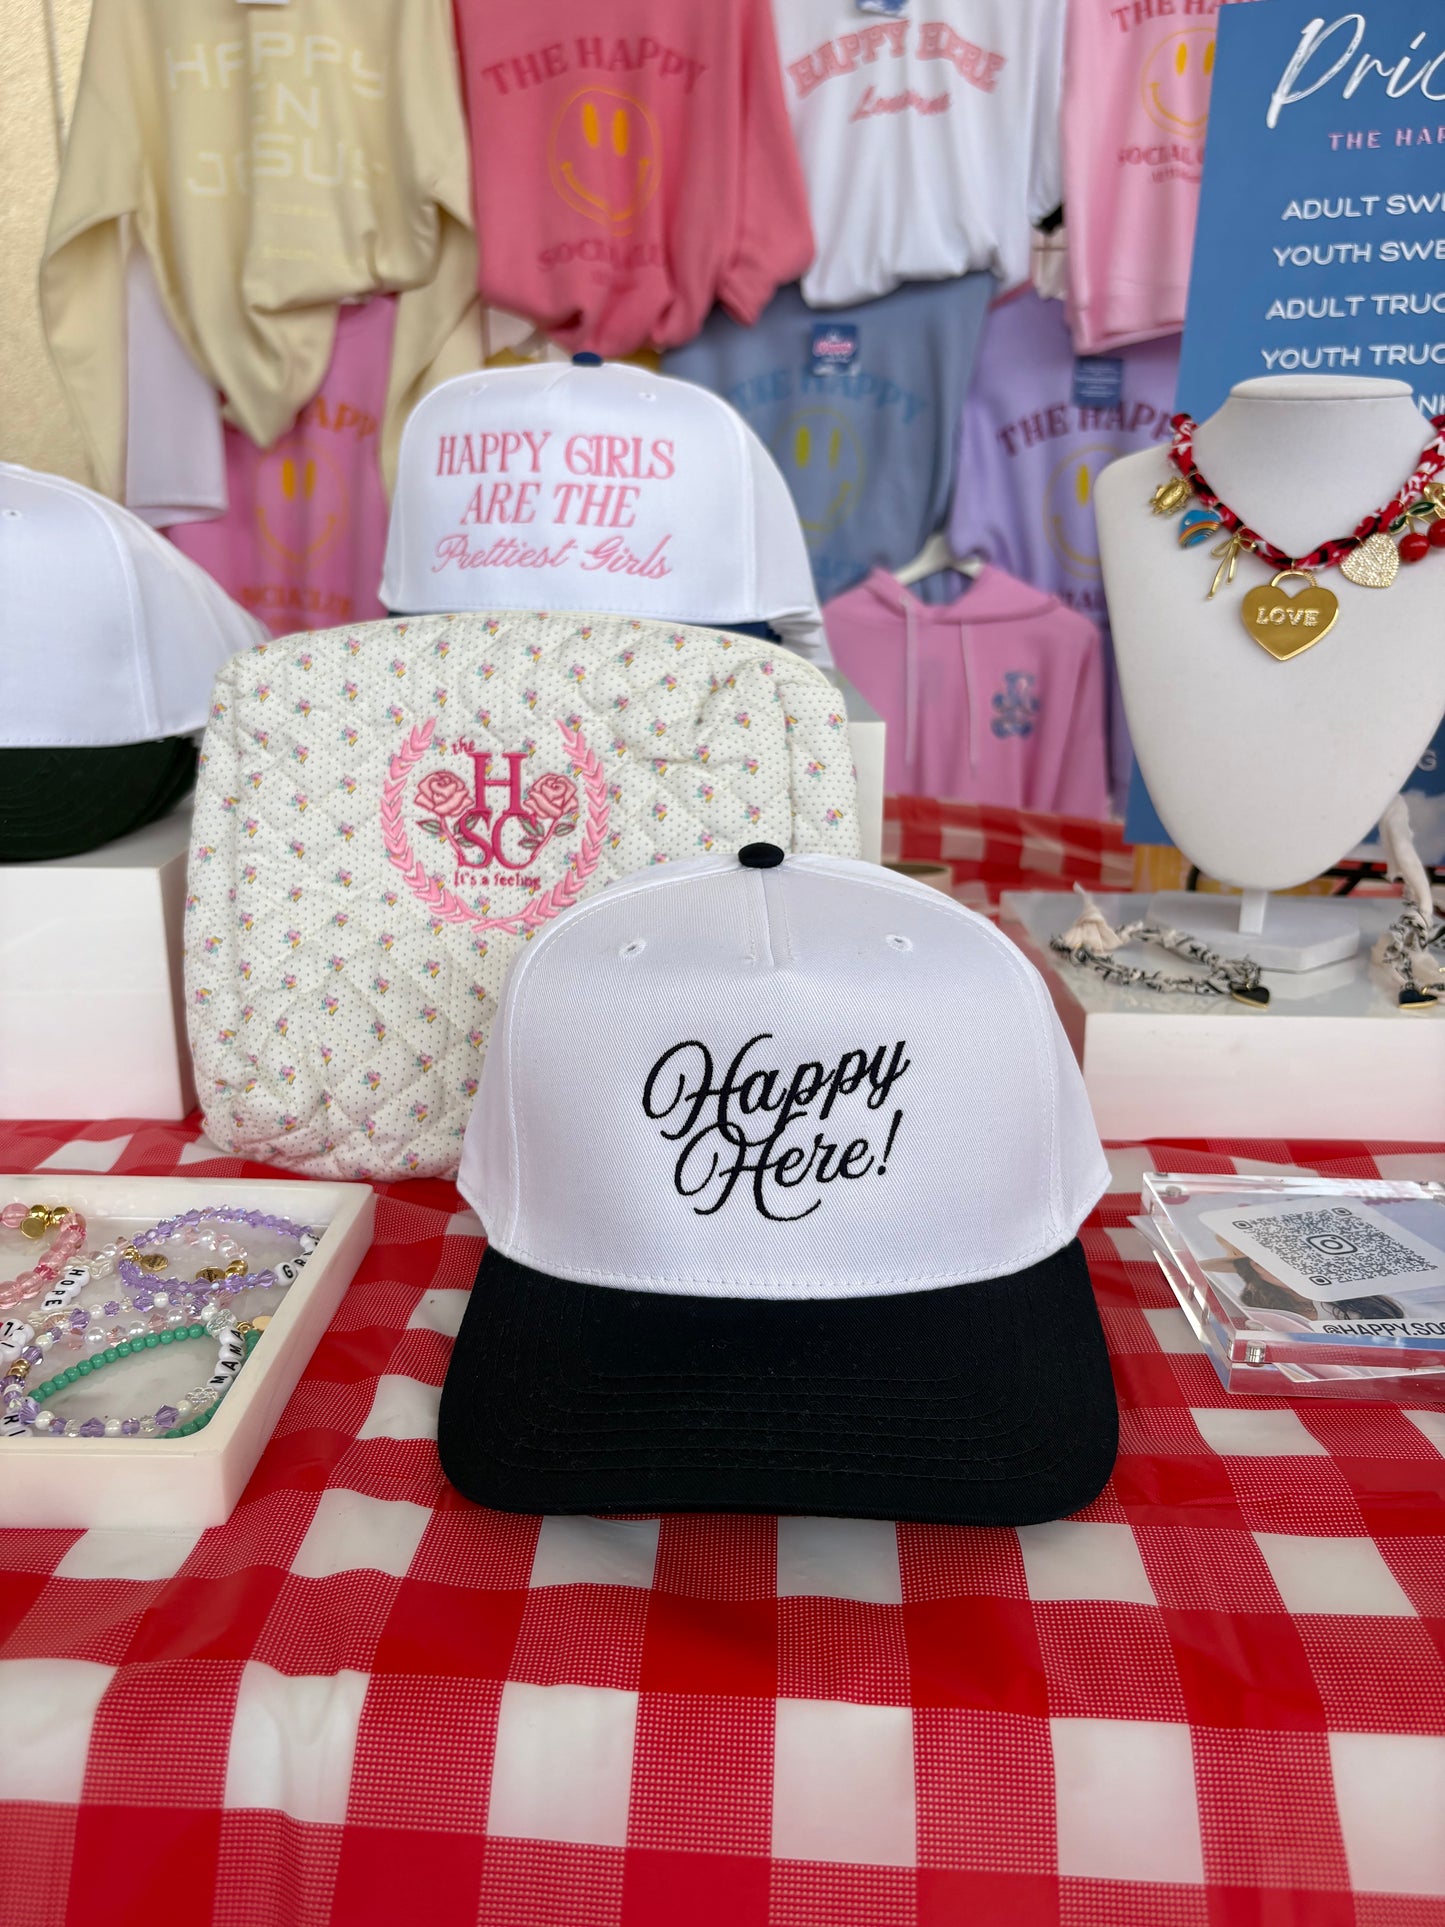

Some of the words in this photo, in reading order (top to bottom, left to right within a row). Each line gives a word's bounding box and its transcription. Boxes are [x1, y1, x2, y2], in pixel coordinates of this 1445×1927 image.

[480, 42, 569, 95] THE
[575, 36, 708, 95] HAPPY
[787, 19, 910, 99] HAPPY
[1328, 131, 1382, 151] THE
[1280, 195, 1381, 221] ADULT
[1272, 242, 1372, 267] YOUTH
[1379, 239, 1445, 263] SWE
[1264, 295, 1366, 321] ADULT
[1260, 345, 1361, 370] YOUTH
[997, 402, 1070, 458] THE
[436, 431, 552, 477] HAPPY
[564, 434, 676, 480] GIRLS
[459, 482, 542, 525] ARE
[553, 483, 641, 528] THE
[431, 533, 578, 573] Prettiest
[579, 534, 673, 579] Girls
[1256, 606, 1320, 627] LOVE
[451, 736, 476, 755] the
[454, 871, 477, 888] It's
[481, 876, 490, 886] a
[493, 872, 541, 891] feeling
[642, 1033, 911, 1148] Happy
[674, 1109, 903, 1222] Here!
[45, 1269, 86, 1306] HOPE
[209, 1329, 244, 1384] MAMA
